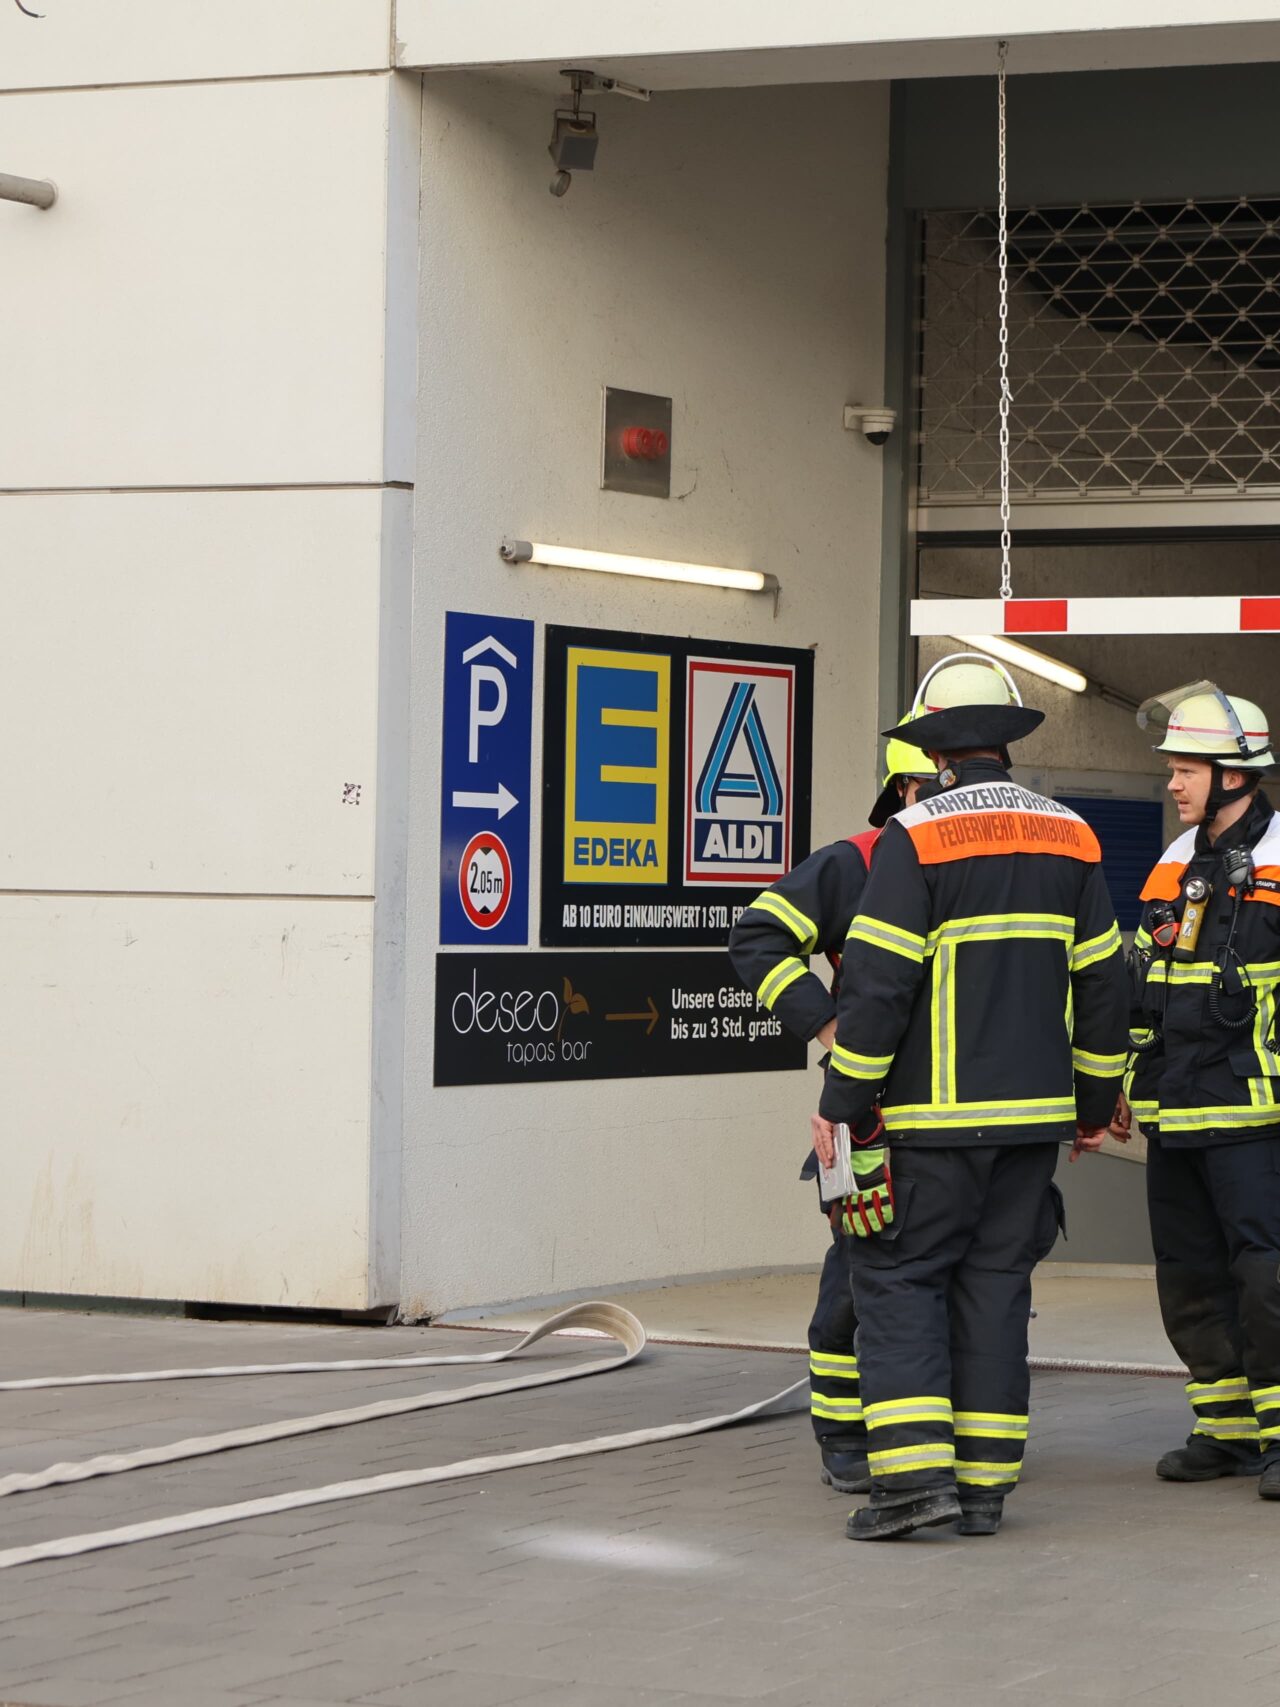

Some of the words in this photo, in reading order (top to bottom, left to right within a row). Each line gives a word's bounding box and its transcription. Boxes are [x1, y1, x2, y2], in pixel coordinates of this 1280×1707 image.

[469, 664, 508, 763] P
[574, 665, 658, 824] E
[702, 823, 773, 860] ALDI
[936, 814, 1018, 848] FEUERWEHR
[1020, 815, 1081, 848] HAMBURG
[573, 837, 659, 867] EDEKA
[562, 904, 577, 928] AB
[579, 905, 591, 928] 10
[593, 904, 622, 928] EURO
[624, 905, 700, 928] EINKAUFSWERT
[702, 906, 707, 928] 1
[708, 905, 730, 928] STD.
[732, 905, 748, 927] FR
[452, 968, 559, 1034] deseo
[671, 988, 715, 1010] Unsere
[718, 986, 753, 1008] Gäste
[671, 1017, 689, 1040] bis
[692, 1022, 707, 1039] zu
[710, 1017, 719, 1038] 3
[722, 1015, 745, 1038] Std.
[748, 1014, 782, 1042] gratis
[507, 1041, 556, 1067] tapas
[561, 1039, 593, 1061] bar
